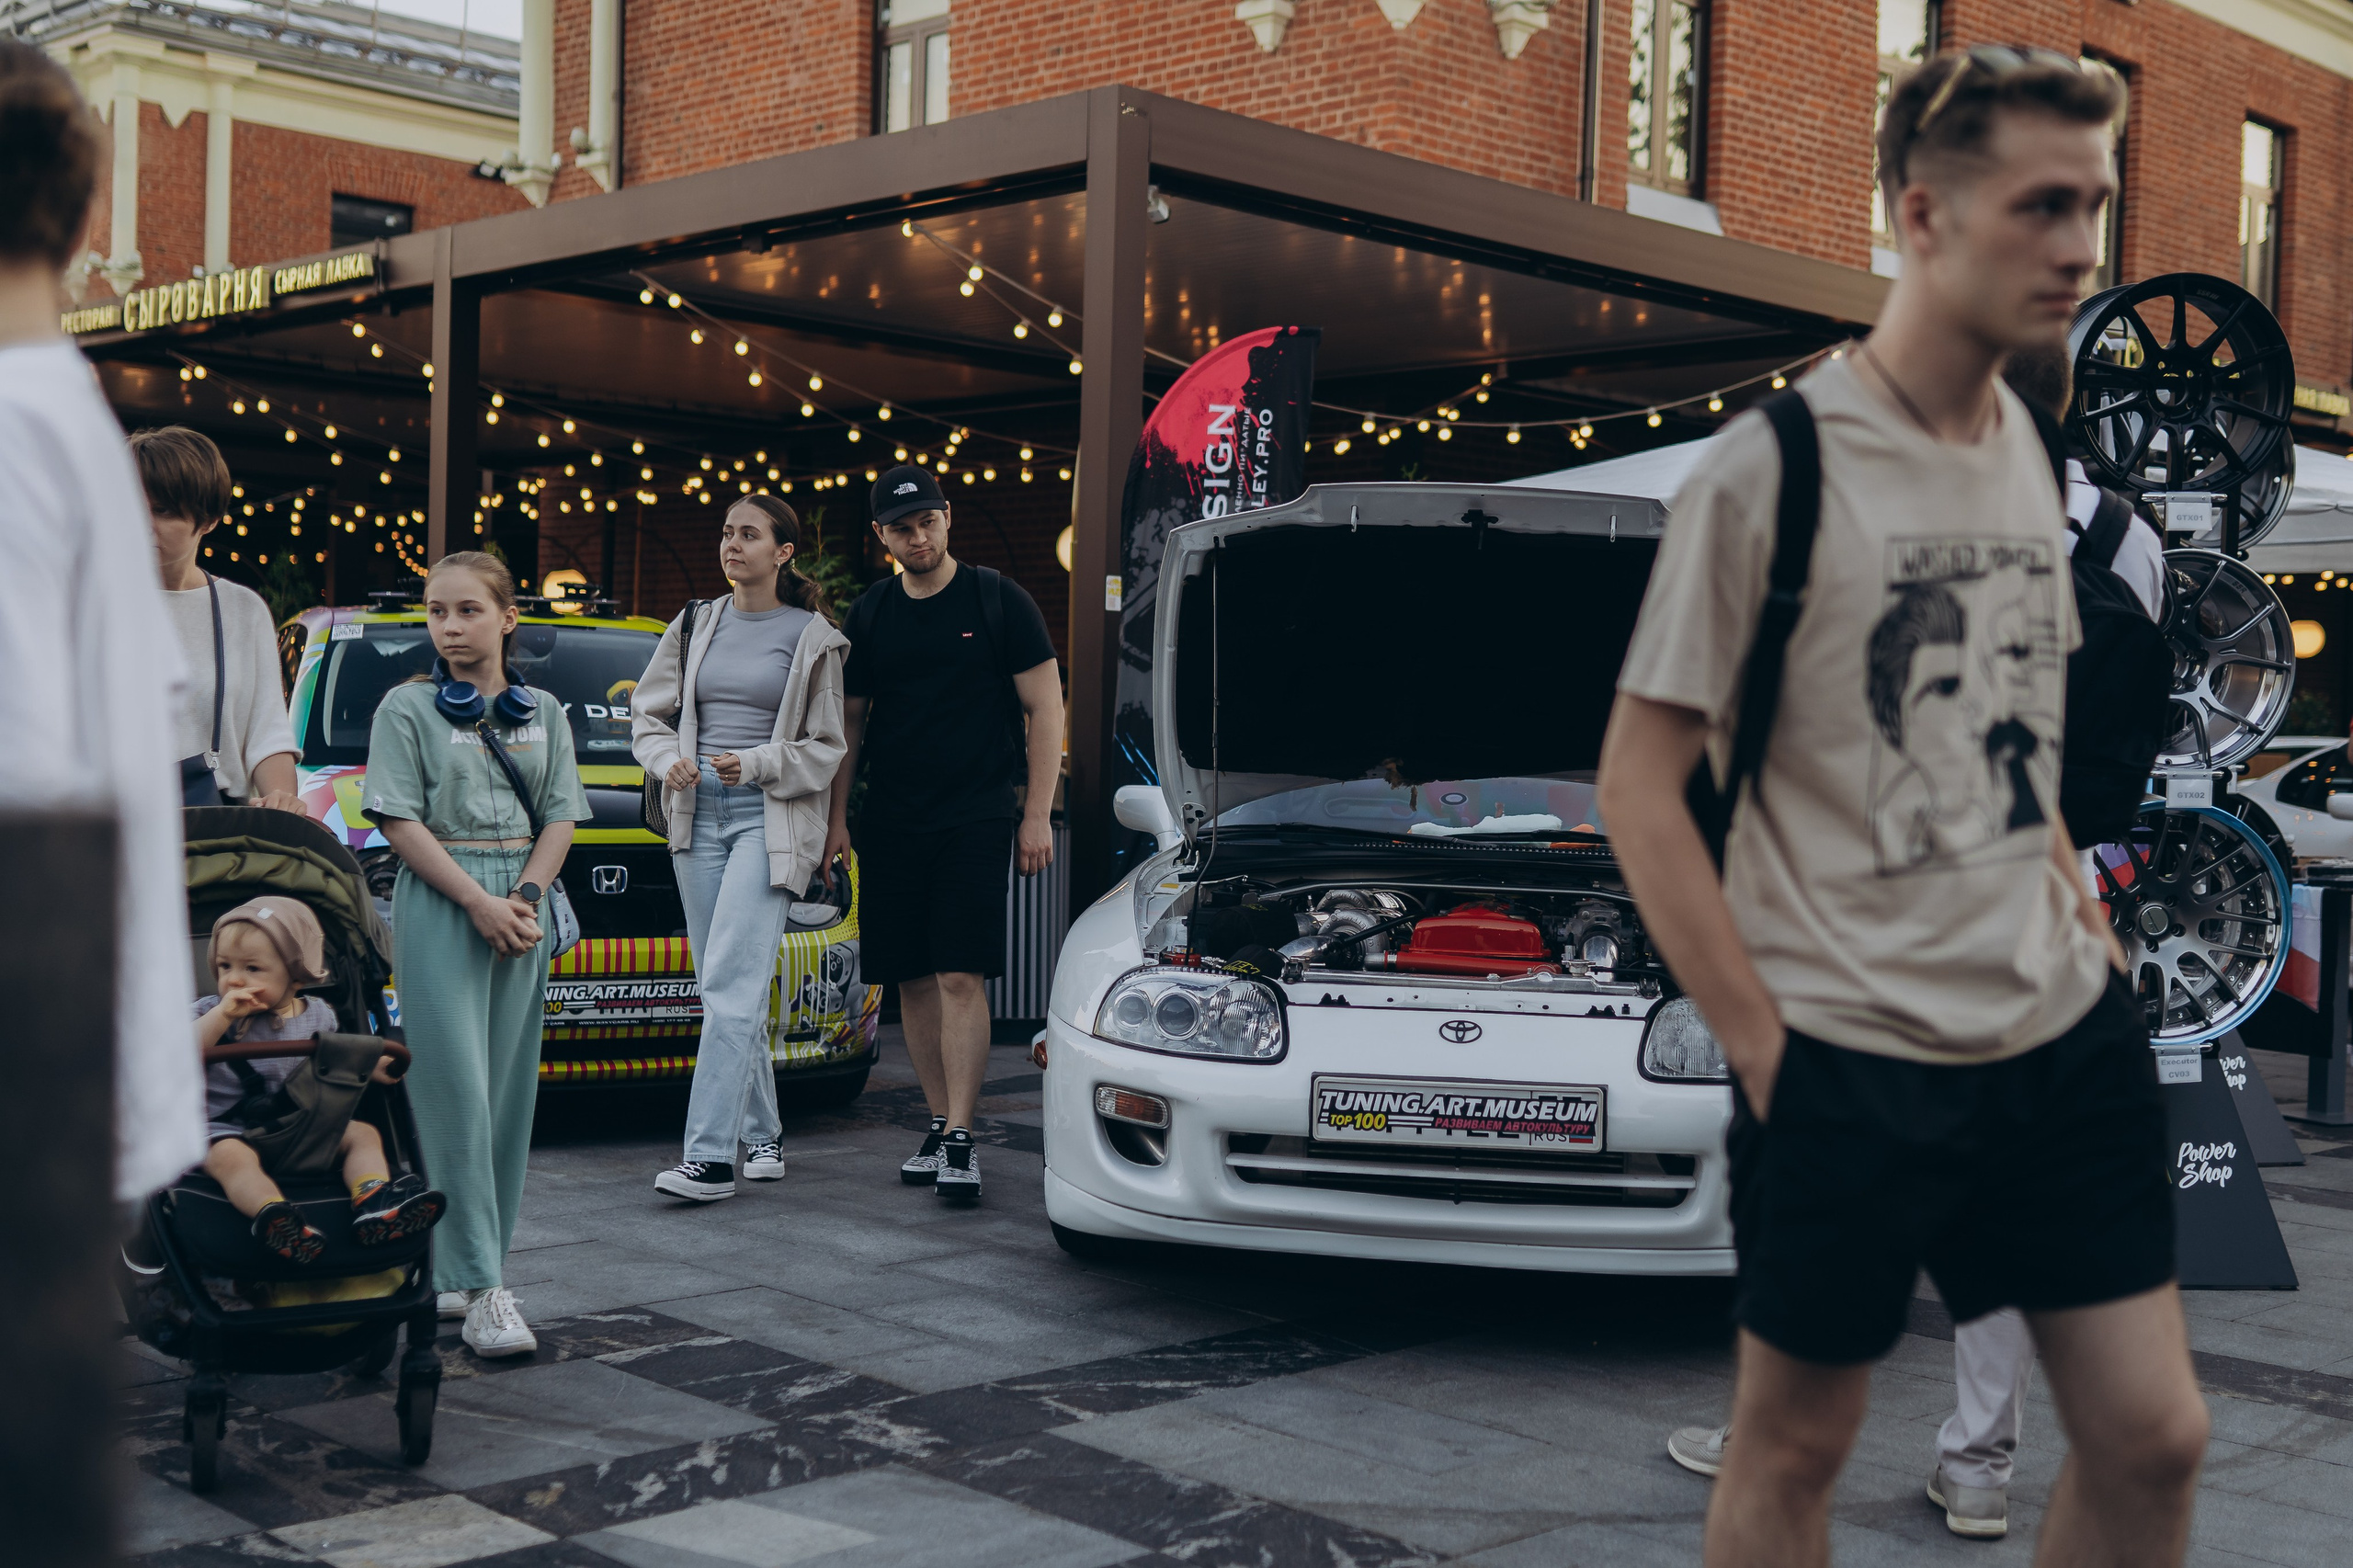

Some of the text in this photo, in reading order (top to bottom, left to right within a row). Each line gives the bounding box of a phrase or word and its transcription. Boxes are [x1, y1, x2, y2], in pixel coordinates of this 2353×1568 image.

[60, 252, 367, 334] РЕСТОРАН СЫРОВАРНЯ СЫРНАЯ ЛАВКА
[1202, 403, 1236, 519] SIGN
[1251, 408, 1274, 508] LEY.PRO
[596, 999, 643, 1008] РАЗВИВАЕМ
[665, 1006, 688, 1014] RUS
[2161, 1058, 2198, 1066] Executor
[1319, 1091, 1598, 1122] TUNING.ART.MUSEUM
[1330, 1113, 1386, 1130] TOP 100
[1435, 1117, 1503, 1131] РАЗВИВАЕМ
[1504, 1121, 1590, 1135] АВТОКУЛЬТУРУ
[2177, 1142, 2237, 1168] Power
[2178, 1161, 2234, 1188] Shop
